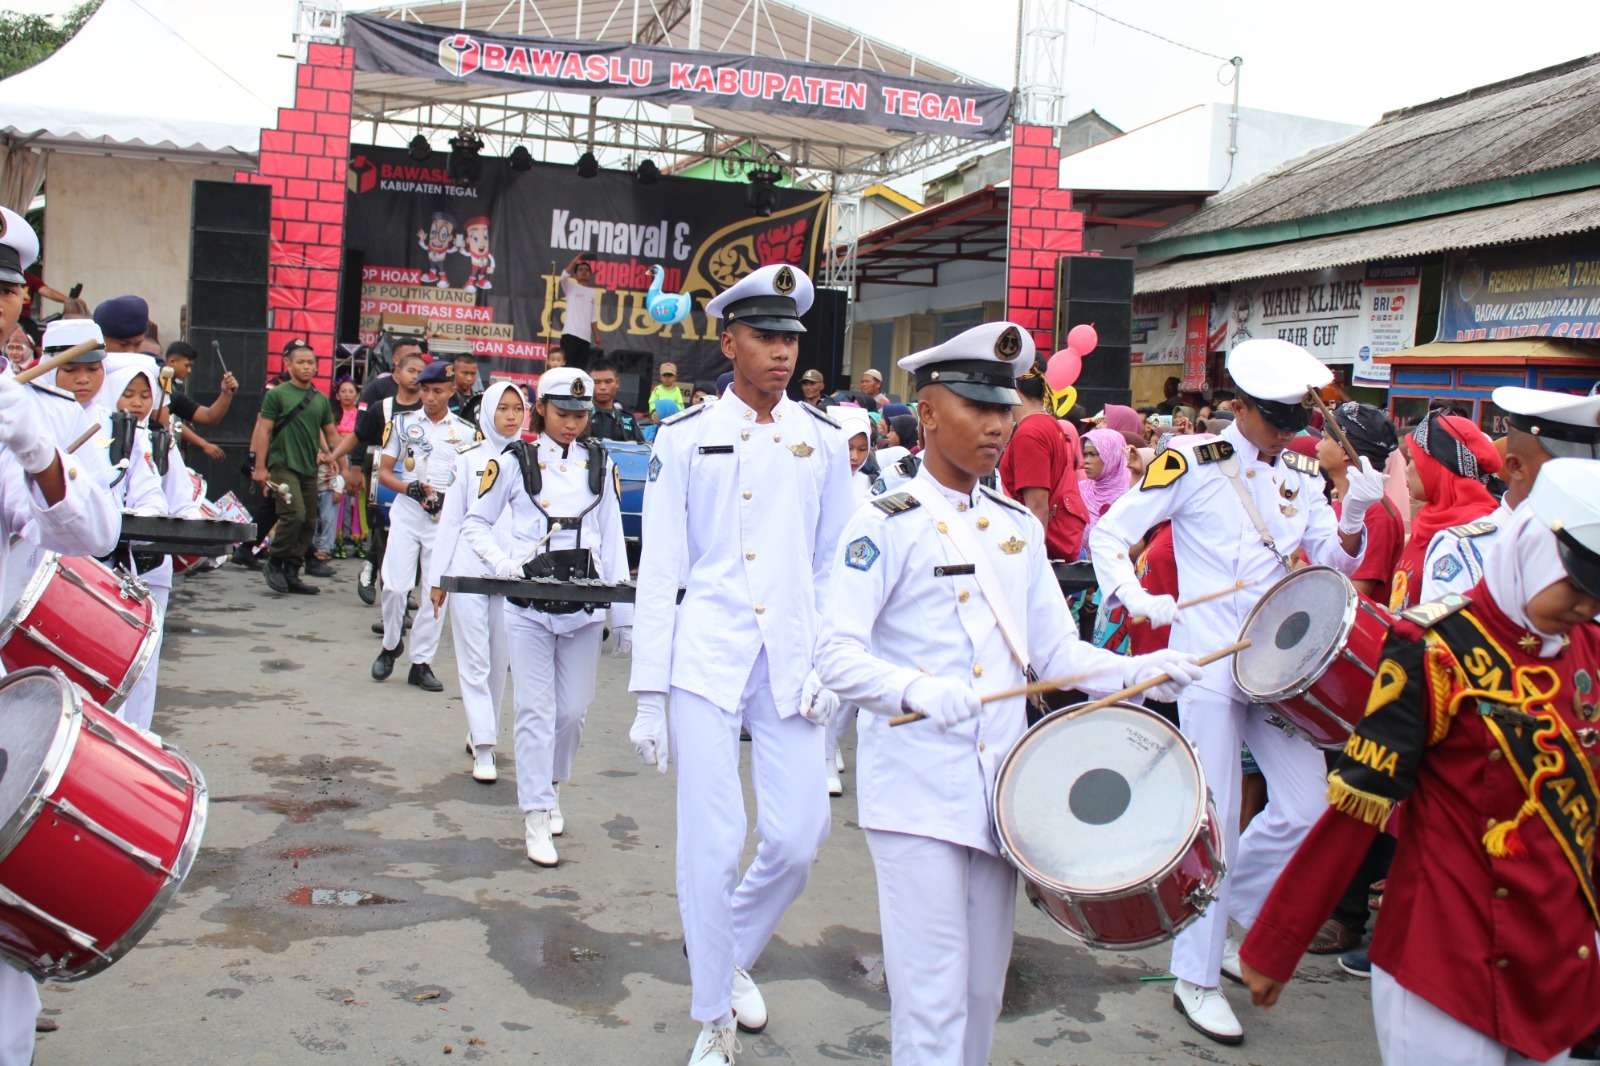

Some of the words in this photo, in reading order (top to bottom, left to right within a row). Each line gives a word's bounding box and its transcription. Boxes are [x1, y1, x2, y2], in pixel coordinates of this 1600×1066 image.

[482, 43, 652, 87] BAWASLU
[669, 62, 867, 110] KABUPATEN
[882, 87, 983, 126] TEGAL
[381, 164, 453, 183] BAWASL
[380, 180, 442, 194] KABUPATEN
[444, 185, 478, 198] TEGAL
[550, 208, 668, 259] Karnaval
[673, 221, 692, 261] &
[380, 268, 420, 284] HOAX
[1487, 269, 1533, 294] REMBUG
[1533, 262, 1571, 291] WARGA
[380, 286, 432, 300] POLITIK
[435, 290, 474, 304] UANG
[1262, 285, 1299, 318] WANI
[1305, 278, 1364, 312] KLIMIS
[1373, 296, 1390, 311] BRI
[379, 302, 452, 319] POLITISASI
[455, 308, 491, 321] SARA
[1475, 304, 1508, 323] BADAN
[1506, 298, 1589, 322] KESWADAYAAN
[437, 322, 512, 339] KEBENCIAN
[1313, 325, 1339, 346] CUT
[507, 344, 548, 357] SANTU
